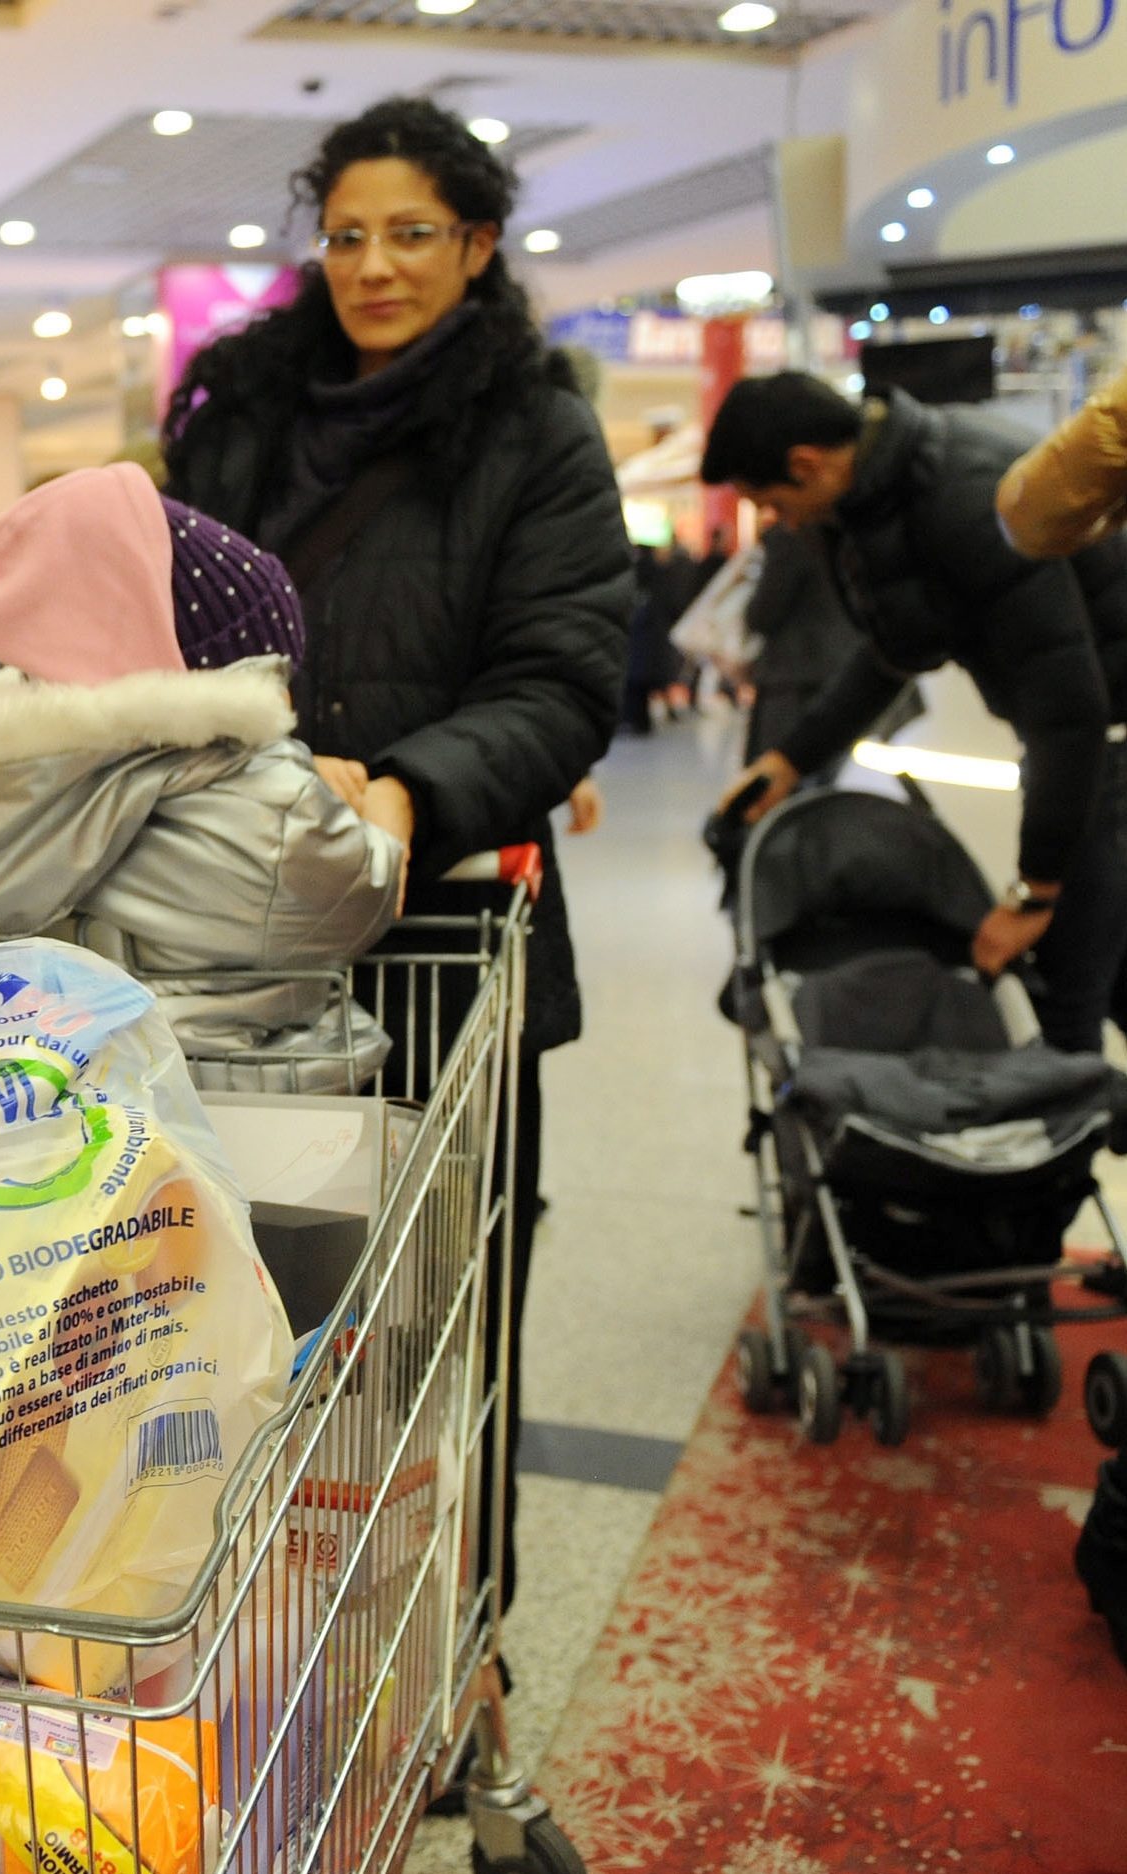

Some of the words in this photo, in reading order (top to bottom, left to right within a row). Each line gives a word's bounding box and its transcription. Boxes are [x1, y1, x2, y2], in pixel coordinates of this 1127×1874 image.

[35, 1032, 71, 1055] dai
[9, 1206, 195, 1276] BIODEGRADABILE
[39, 1321, 51, 1341] al
[56, 1308, 93, 1334] 100%
[97, 1305, 104, 1319] e
[107, 1275, 206, 1314] compostabile
[53, 1278, 119, 1312] sacchetto
[9, 1357, 20, 1374] è
[24, 1332, 92, 1370] realizzato
[95, 1325, 108, 1342] in
[28, 1377, 36, 1391] a
[40, 1362, 72, 1386] base
[75, 1352, 88, 1372] di
[135, 1328, 147, 1346] di
[150, 1319, 189, 1341] mais.
[18, 1388, 63, 1417] essere
[66, 1361, 126, 1395] utilizzato
[90, 1386, 112, 1408] dei
[114, 1370, 147, 1399] rifiuti
